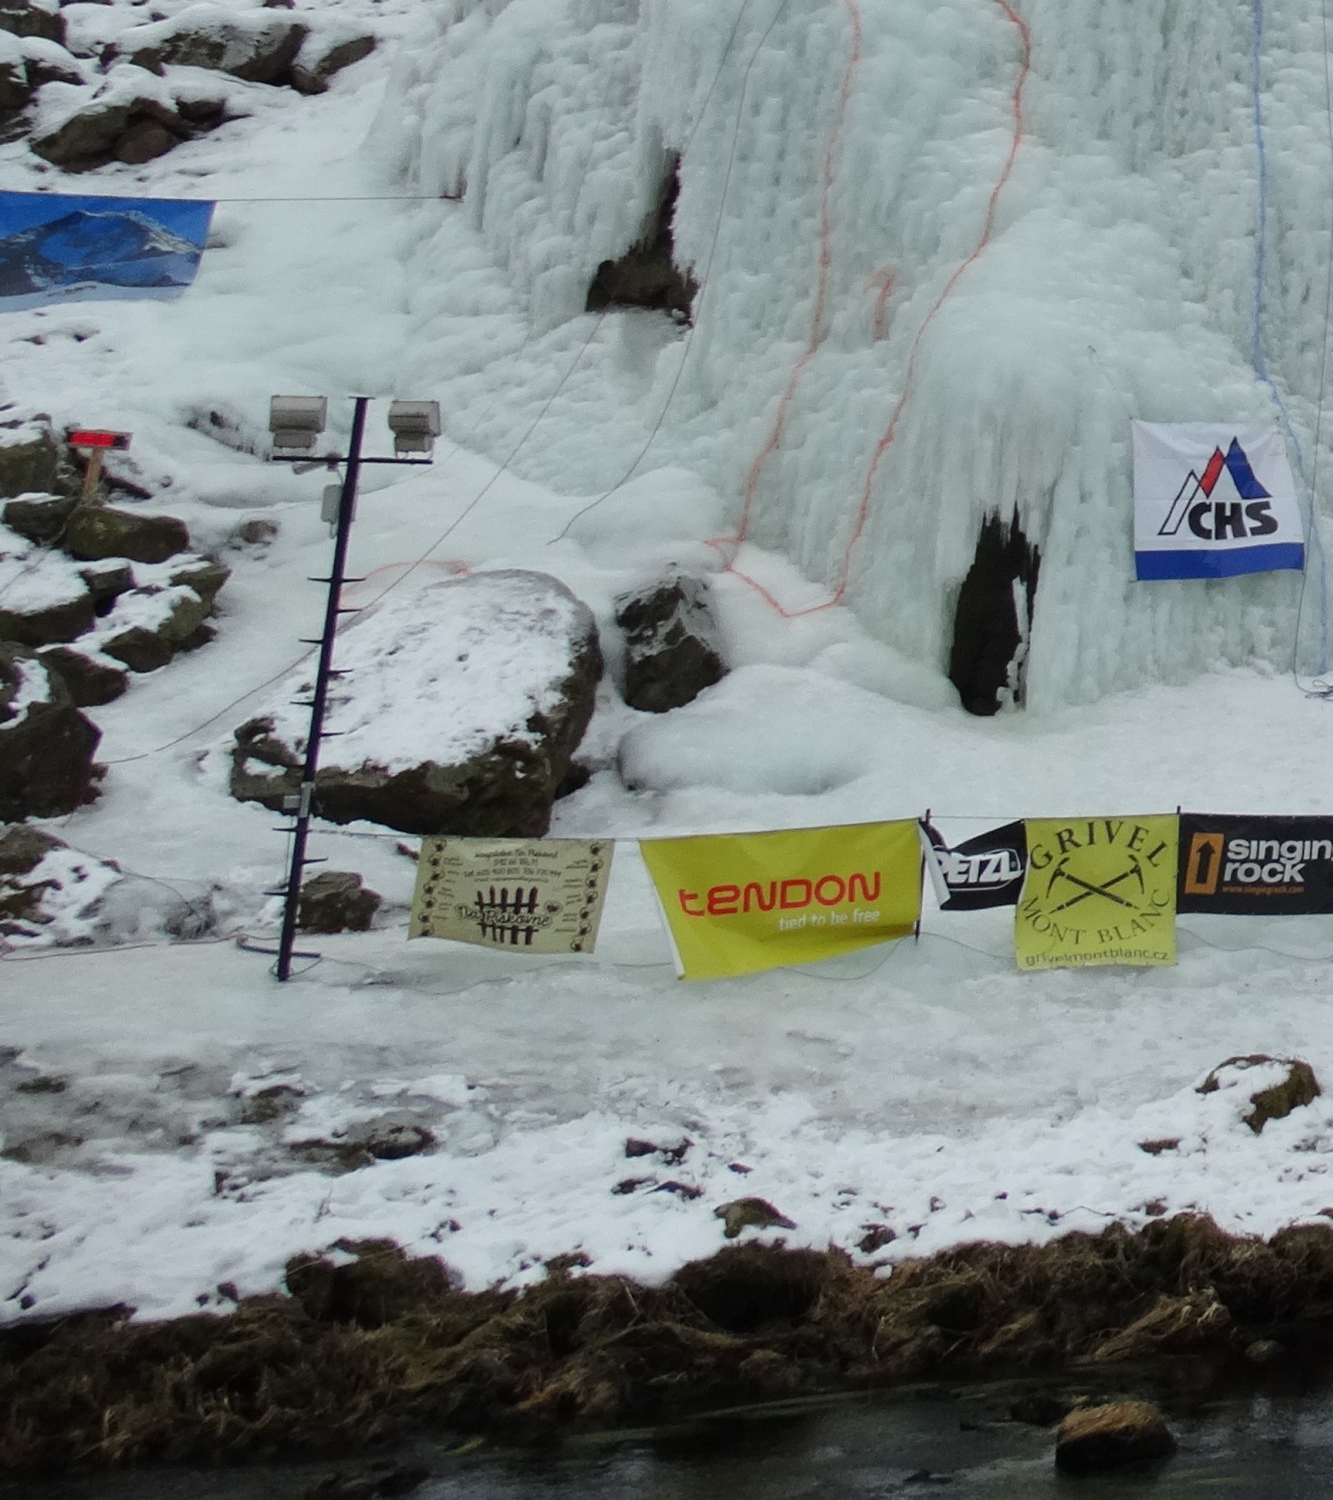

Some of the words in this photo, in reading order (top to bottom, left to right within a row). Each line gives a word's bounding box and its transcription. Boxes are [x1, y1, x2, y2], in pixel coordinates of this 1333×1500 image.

[1029, 820, 1167, 869] GRIVEL
[1223, 862, 1307, 883] rock
[778, 915, 807, 931] tied
[811, 914, 826, 926] to
[830, 911, 848, 924] be
[853, 908, 881, 923] free
[1023, 896, 1086, 945] MONT
[1097, 889, 1171, 945] BLANC
[1025, 947, 1169, 967] grivelmontblanc.cz
